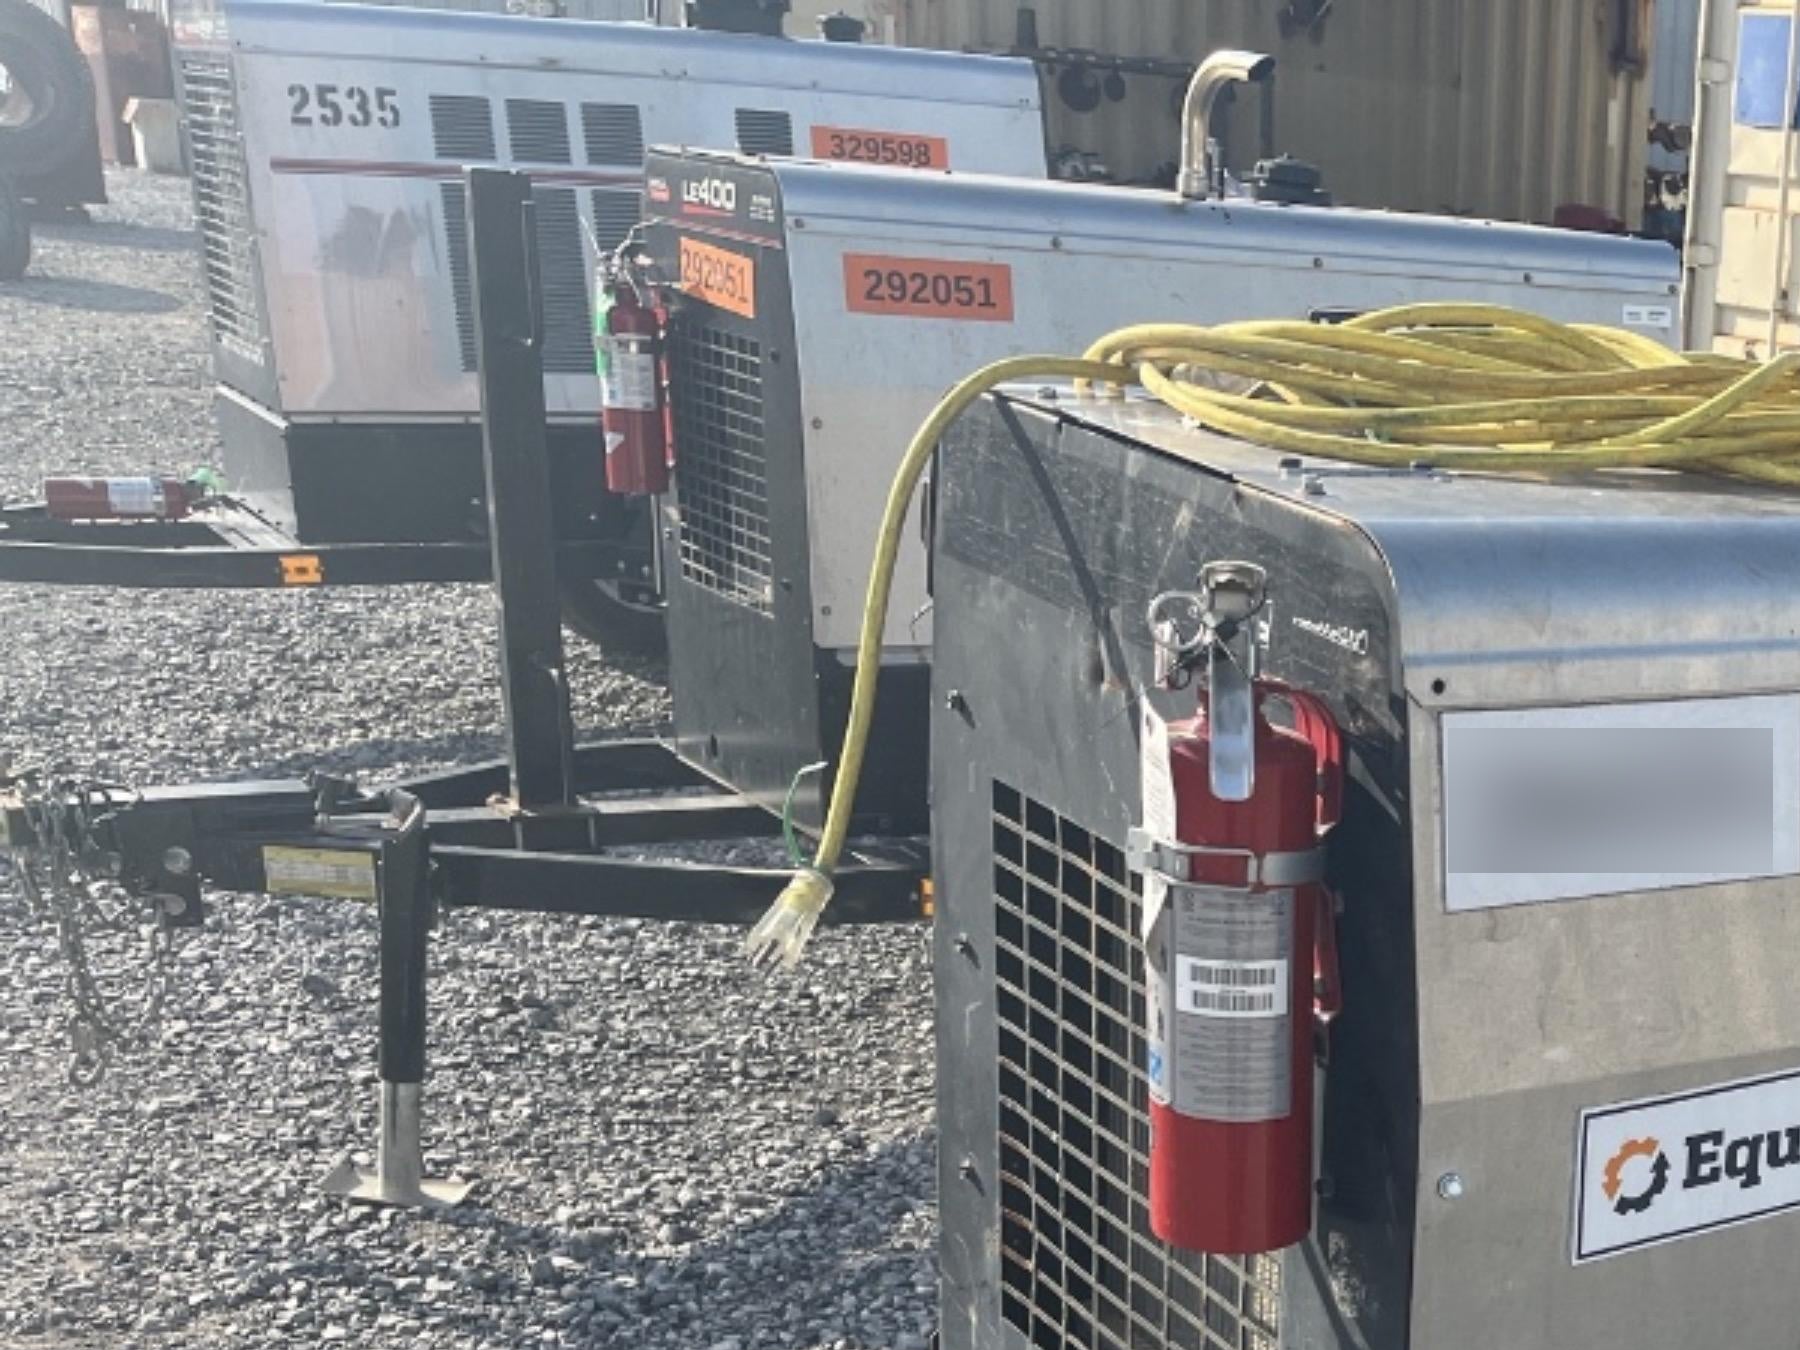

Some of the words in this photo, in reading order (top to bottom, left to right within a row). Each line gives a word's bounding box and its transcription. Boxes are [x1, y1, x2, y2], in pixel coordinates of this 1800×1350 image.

[287, 83, 400, 127] 2535
[829, 133, 931, 168] 329598
[863, 269, 997, 308] 292051
